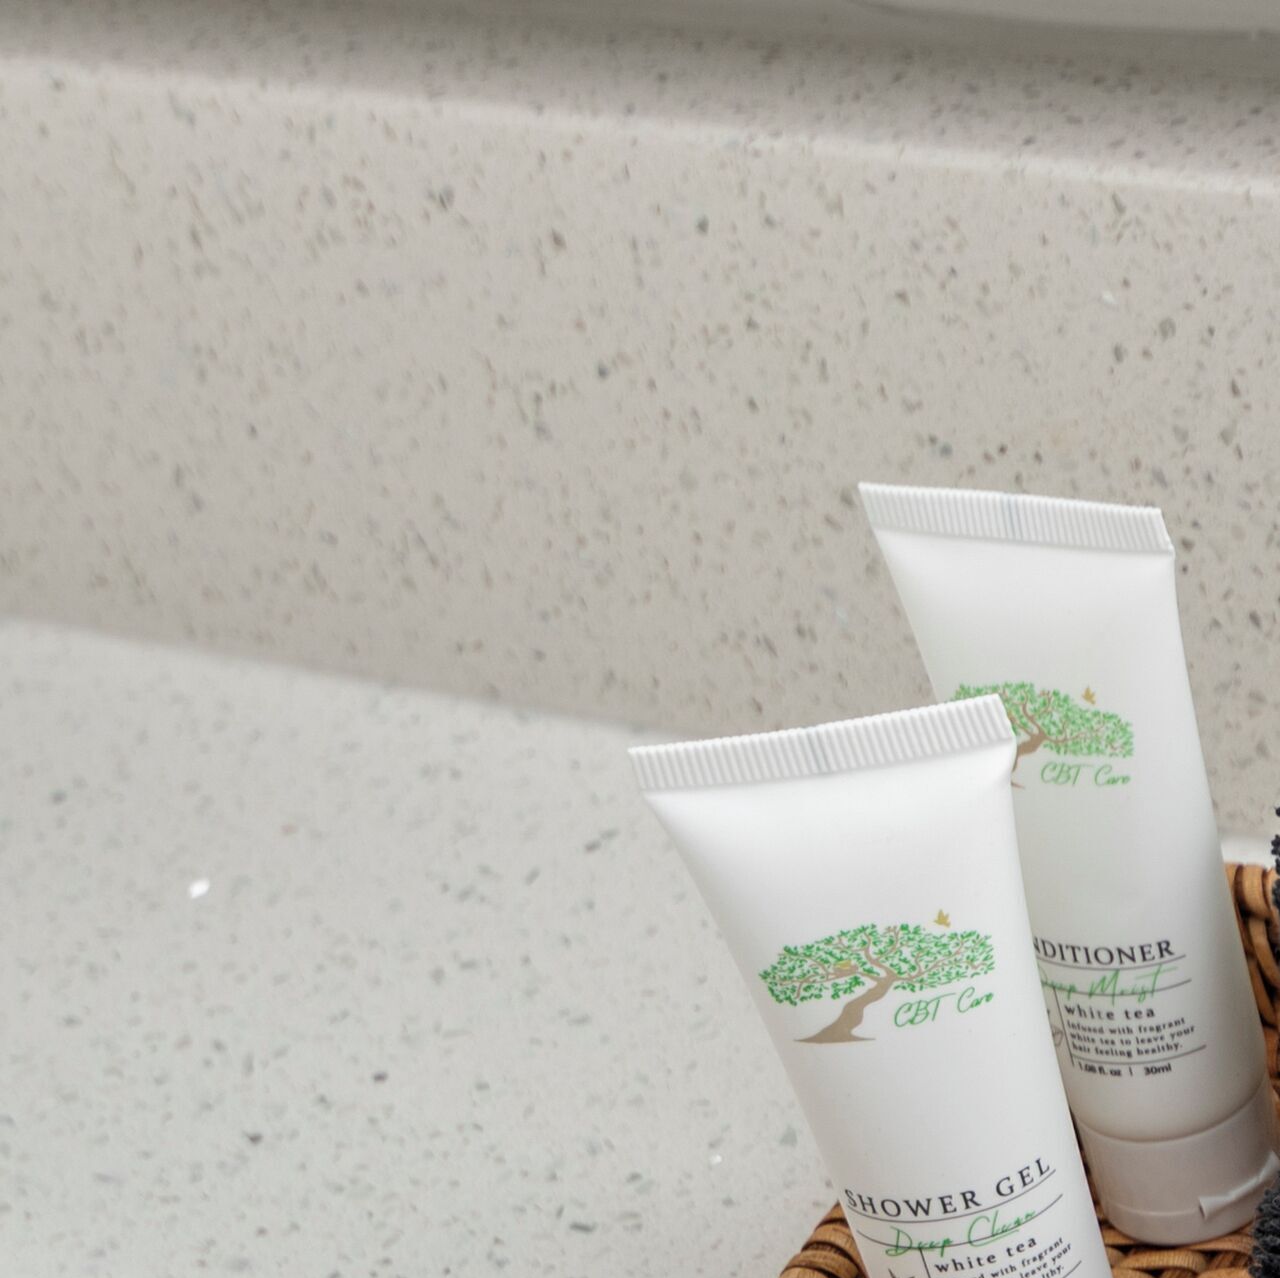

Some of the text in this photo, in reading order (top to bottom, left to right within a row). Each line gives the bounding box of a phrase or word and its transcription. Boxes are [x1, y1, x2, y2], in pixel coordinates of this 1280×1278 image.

[1040, 761, 1131, 787] CBT Care
[894, 986, 994, 1028] CBT Care
[1064, 1004, 1155, 1020] white tea
[1070, 1032, 1095, 1043] white
[1135, 1034, 1164, 1044] leave
[1170, 1025, 1194, 1040] your
[1109, 1026, 1133, 1034] with
[1138, 1017, 1185, 1033] fragrant
[1072, 1041, 1090, 1052] hair
[1095, 1047, 1132, 1058] feeling
[1144, 1063, 1172, 1076] 30ml
[845, 1158, 1051, 1217] SHOWER GEL
[885, 1210, 1036, 1257] Deep Clean
[934, 1238, 1037, 1273] white tea
[991, 1265, 1017, 1278] with
[1021, 1237, 1064, 1268] fragrant
[1051, 1243, 1072, 1264] your
